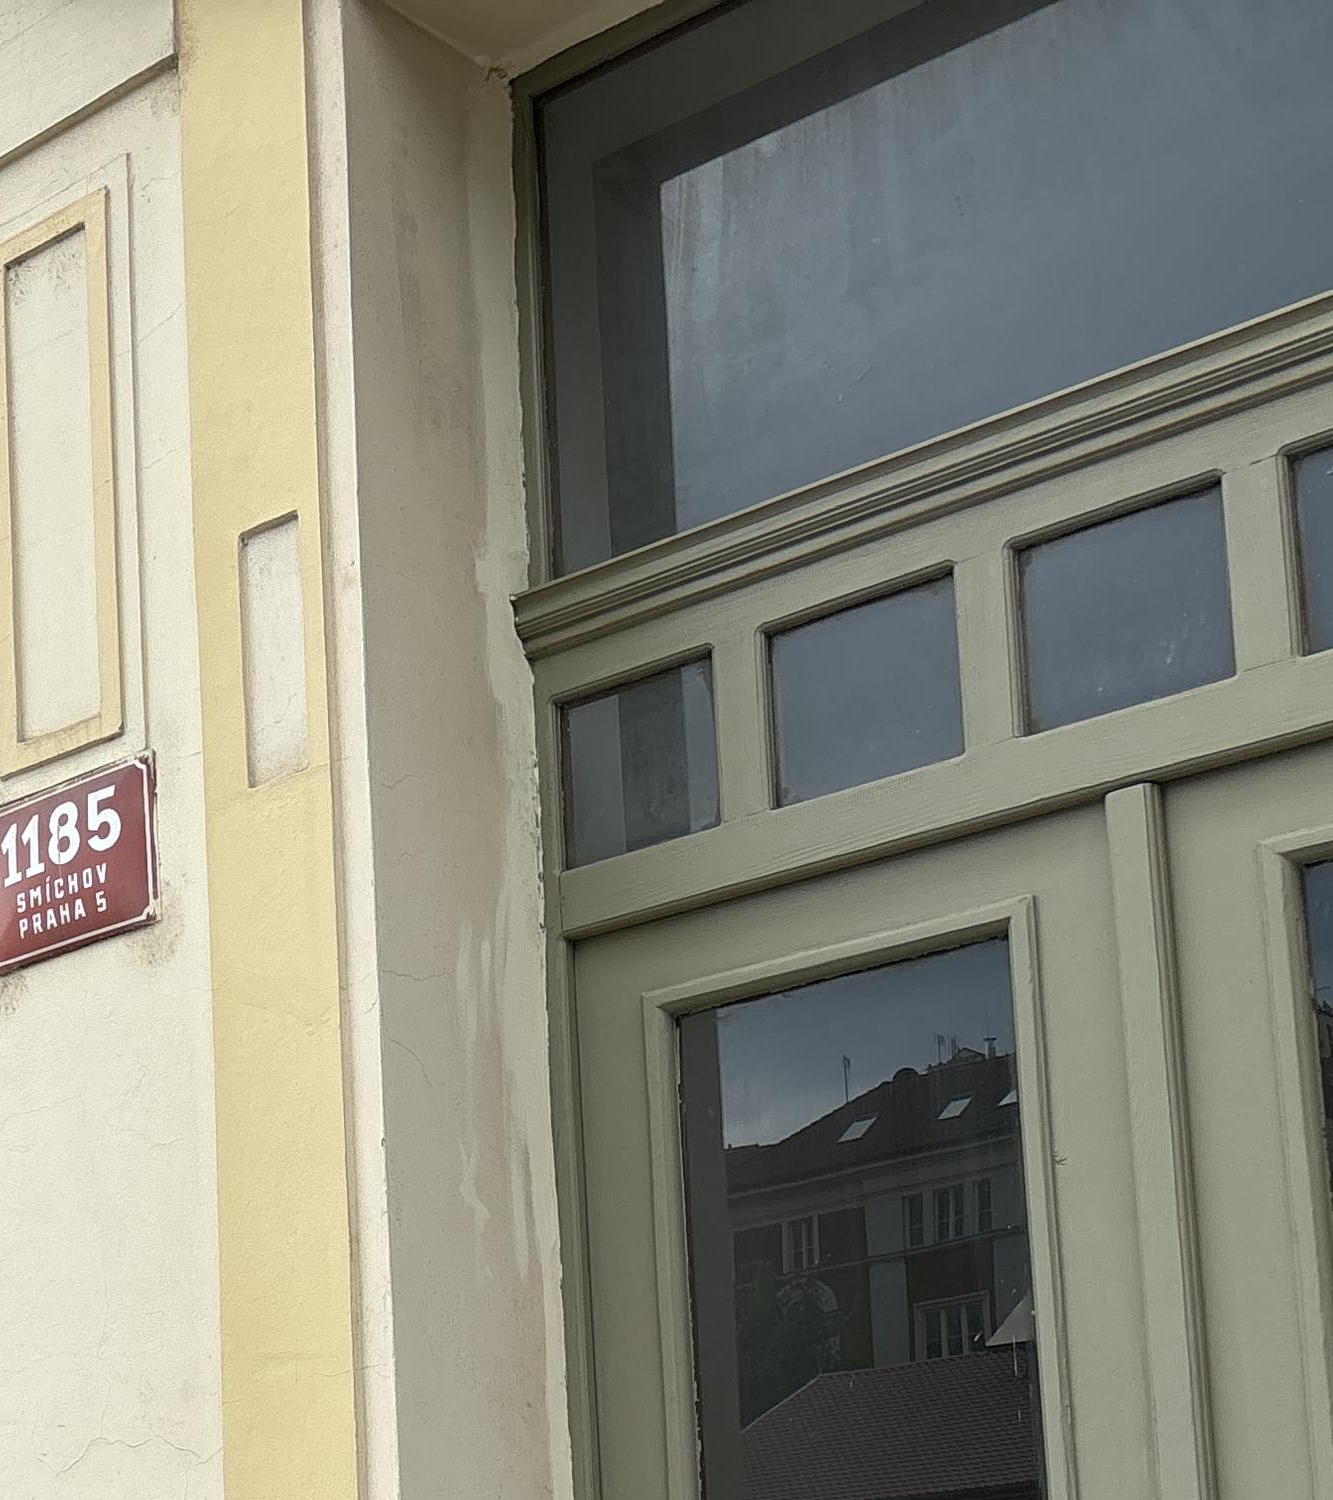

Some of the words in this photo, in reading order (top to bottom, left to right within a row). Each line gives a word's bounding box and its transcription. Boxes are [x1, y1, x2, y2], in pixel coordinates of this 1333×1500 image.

[0, 784, 122, 888] 1185
[16, 862, 108, 914] SMÍCHOV
[19, 898, 86, 939] PRAHA
[95, 890, 108, 912] 5
